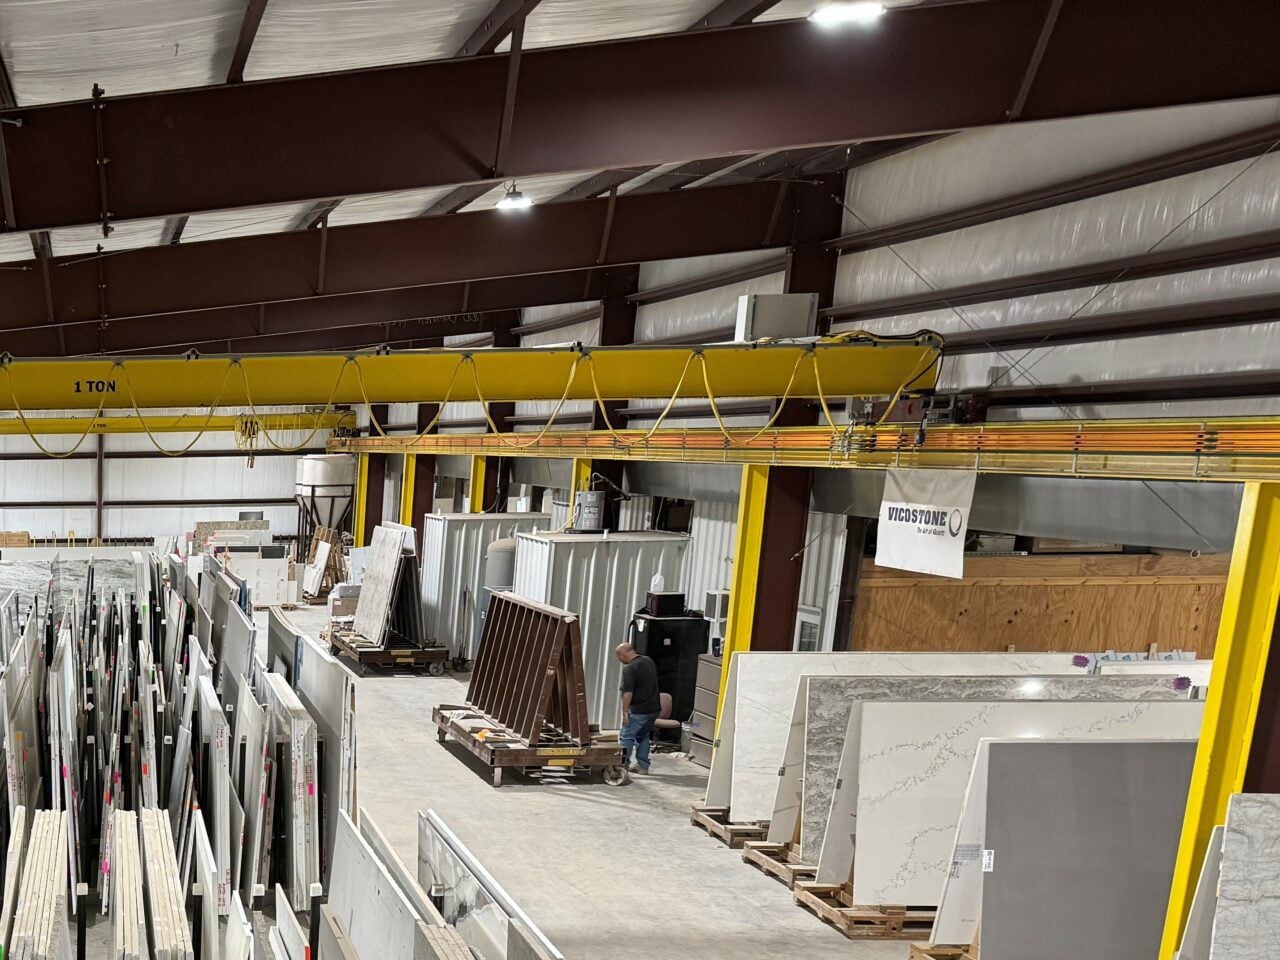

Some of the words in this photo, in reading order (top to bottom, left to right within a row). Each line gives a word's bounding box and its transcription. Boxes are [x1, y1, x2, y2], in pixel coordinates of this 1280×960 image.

[74, 381, 82, 393] 1
[86, 380, 116, 393] TON
[888, 506, 948, 527] VICOSTONE
